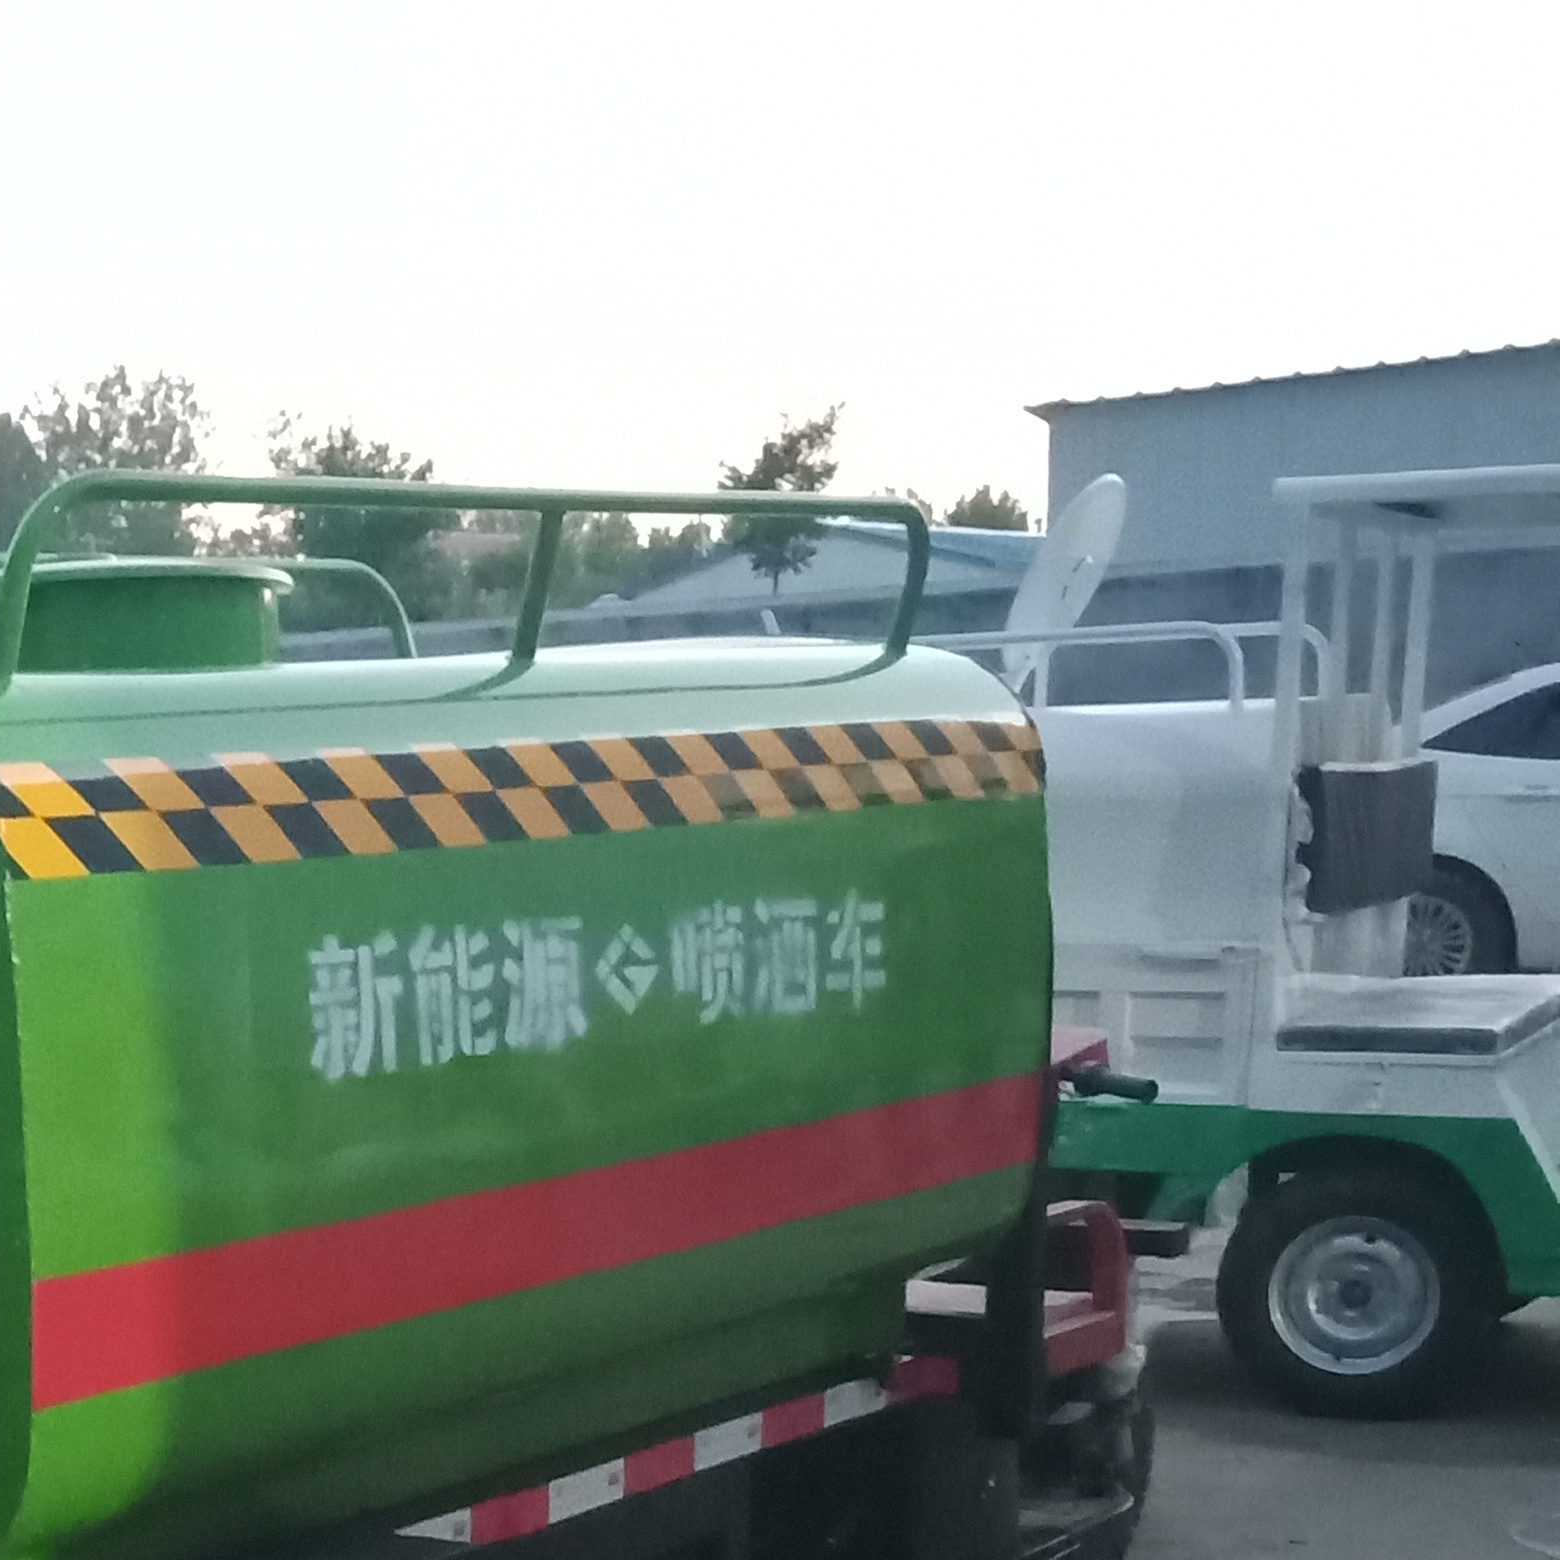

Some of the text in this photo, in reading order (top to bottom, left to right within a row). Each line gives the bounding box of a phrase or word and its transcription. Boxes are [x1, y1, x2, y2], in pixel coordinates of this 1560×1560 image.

[308, 886, 887, 1082] 新能源 喷洒车
